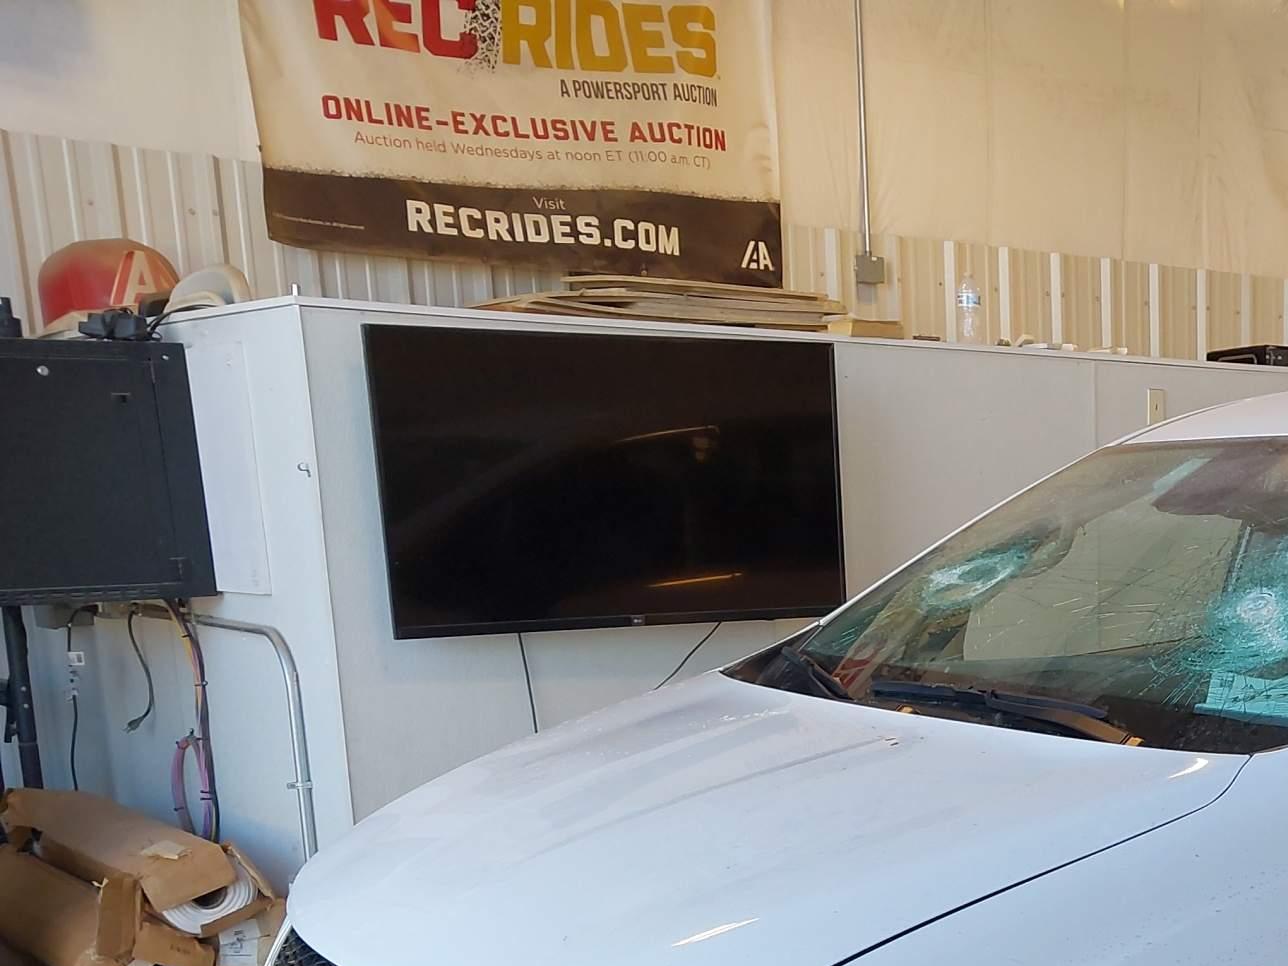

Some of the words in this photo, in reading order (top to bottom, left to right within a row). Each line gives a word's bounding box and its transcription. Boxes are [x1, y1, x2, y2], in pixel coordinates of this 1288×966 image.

[313, 0, 478, 59] REC
[502, 0, 718, 78] RIDES
[560, 79, 571, 98] A
[573, 80, 667, 101] POWERSPORT
[673, 83, 718, 107] AUCTION
[322, 94, 618, 143] ONLINE-EXCLUSIVE
[629, 121, 726, 151] AUCTION
[354, 131, 412, 150] Auction
[415, 137, 447, 153] held
[451, 143, 542, 160] Wednesdays
[547, 151, 561, 161] at
[565, 150, 601, 161] noon
[606, 150, 623, 161] ET
[693, 155, 711, 170] CT)
[533, 196, 565, 210] Visit
[406, 200, 680, 256] RECRIDES.COM
